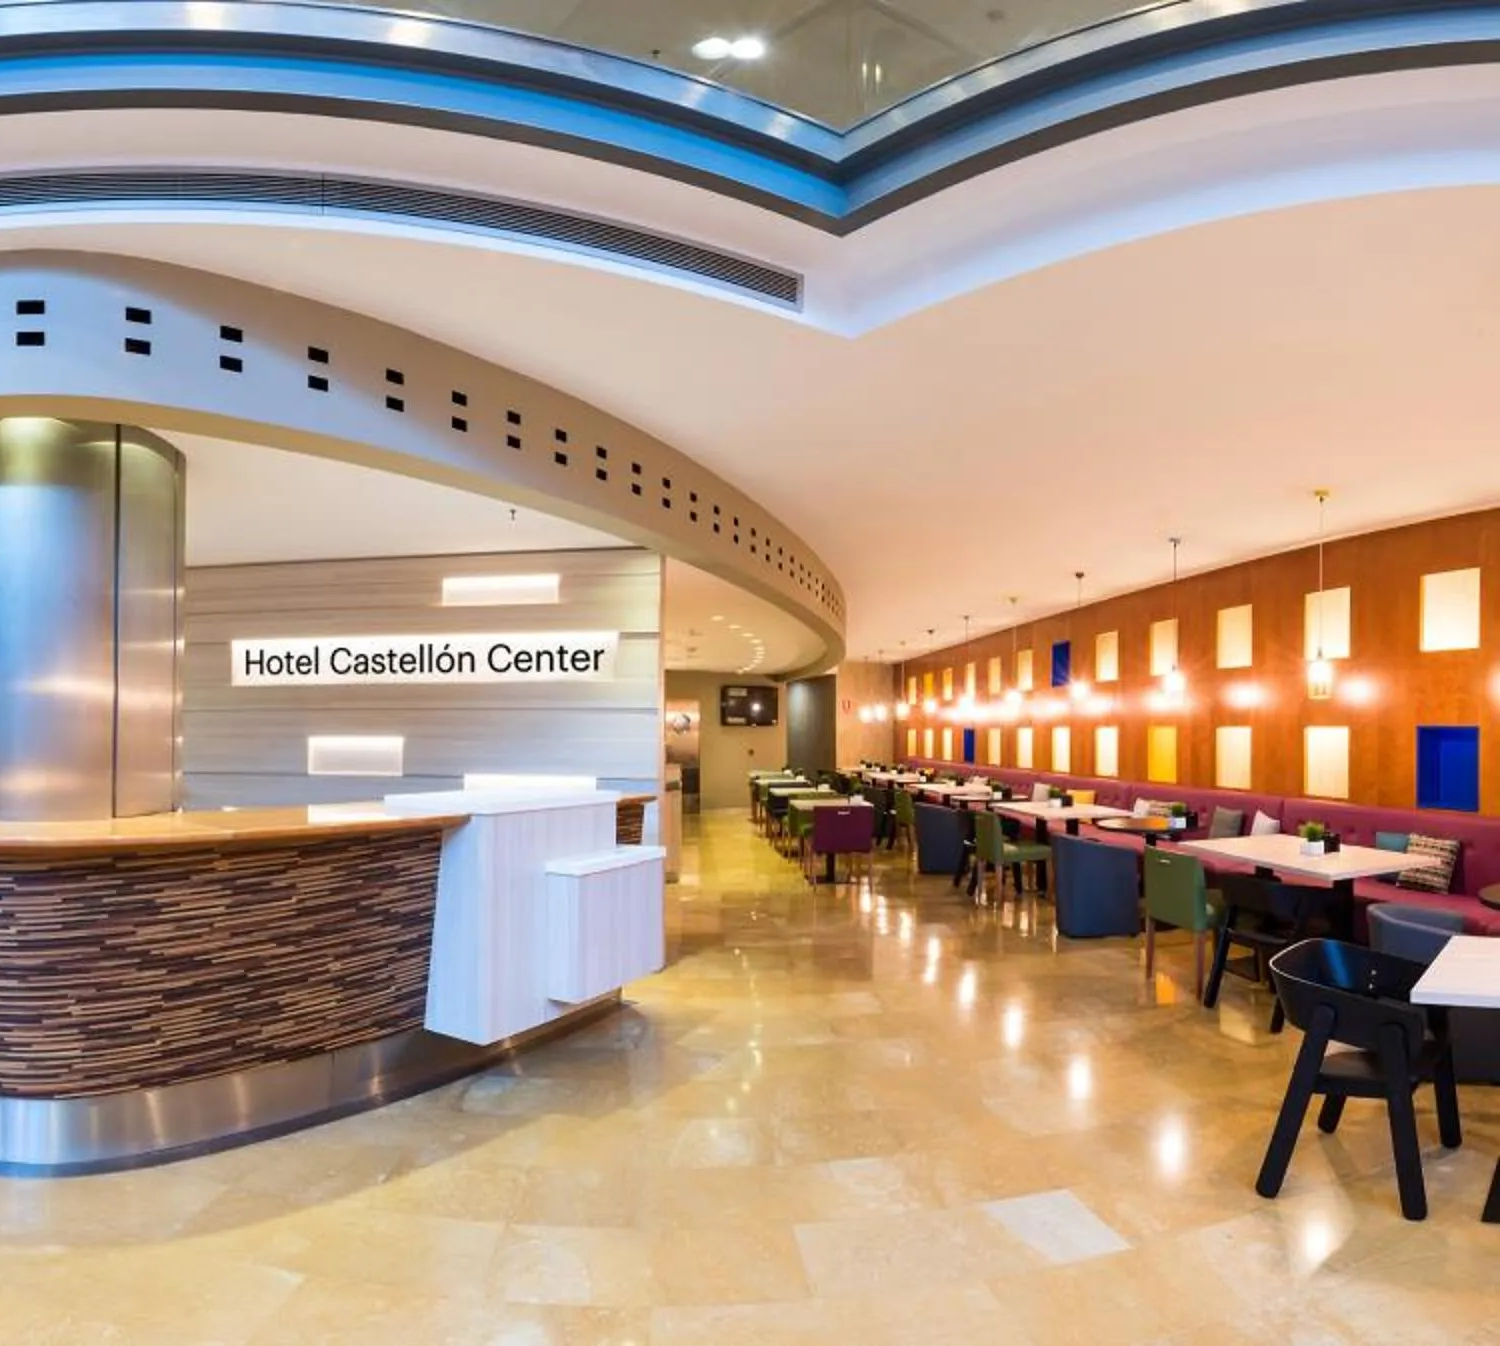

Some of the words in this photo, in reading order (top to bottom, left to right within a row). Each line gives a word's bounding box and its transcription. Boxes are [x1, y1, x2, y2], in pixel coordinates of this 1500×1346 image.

[244, 646, 319, 675] Hotel
[329, 643, 476, 675] Castellón
[487, 642, 605, 673] Center
